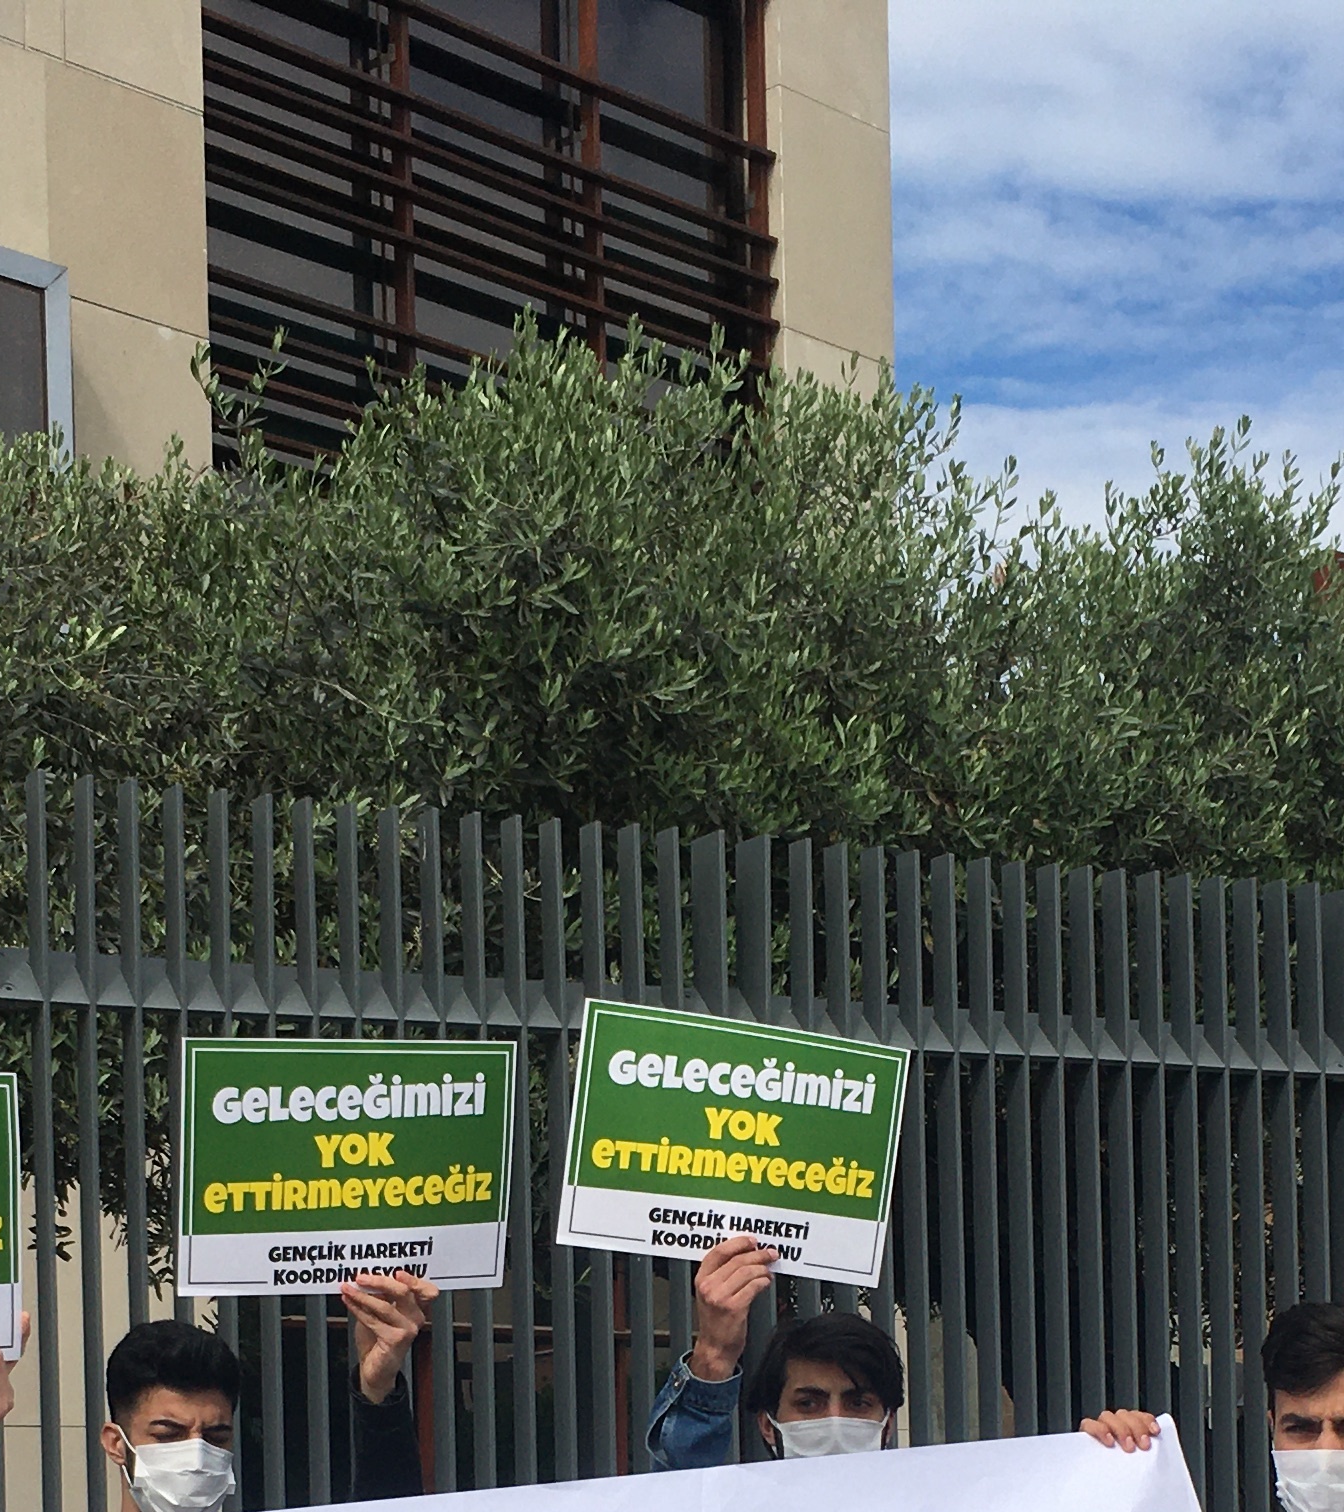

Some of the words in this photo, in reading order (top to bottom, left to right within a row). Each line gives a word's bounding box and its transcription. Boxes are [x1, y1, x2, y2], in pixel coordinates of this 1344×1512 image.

[703, 1106, 783, 1148] YOK
[315, 1132, 395, 1168] YOK
[649, 1207, 725, 1231] GENÇLİK
[729, 1215, 810, 1240] HAREKETİ
[268, 1241, 346, 1266] GENÇLİK
[350, 1236, 433, 1260] HAREKETİ
